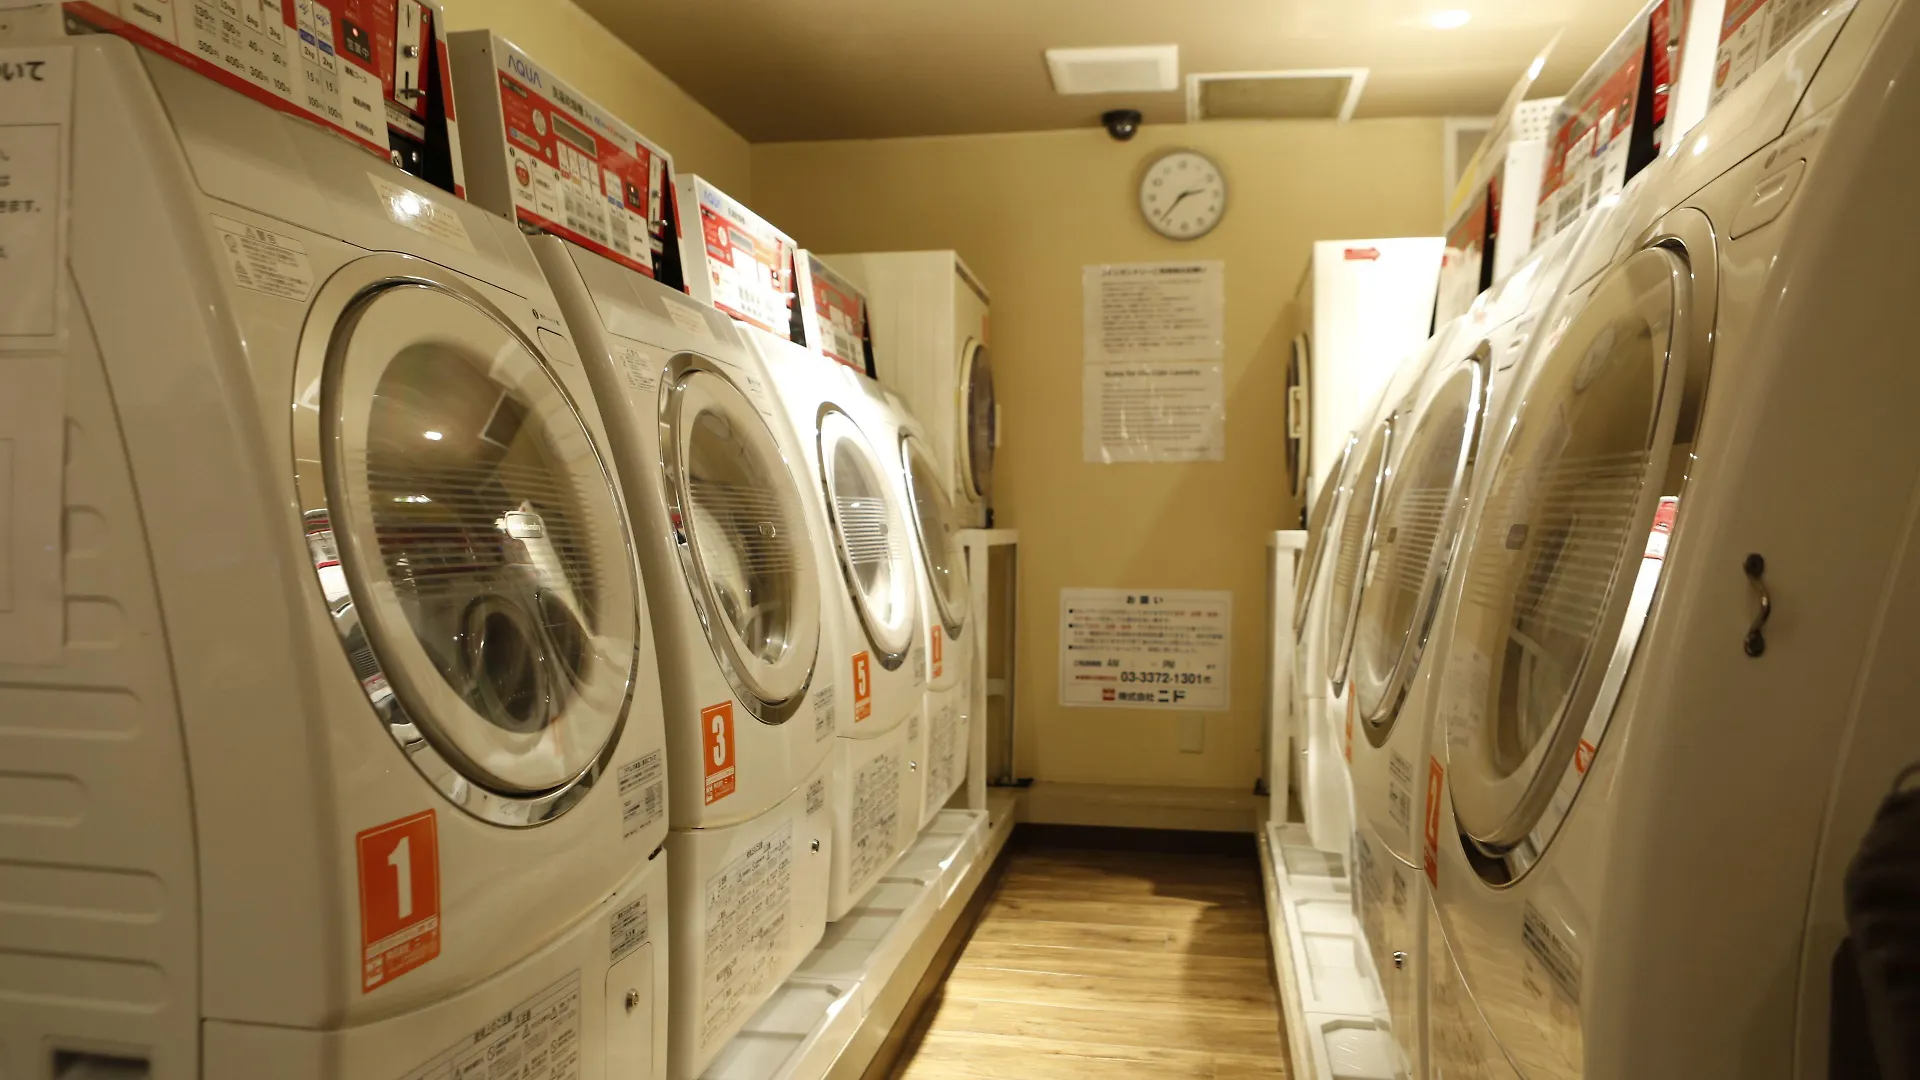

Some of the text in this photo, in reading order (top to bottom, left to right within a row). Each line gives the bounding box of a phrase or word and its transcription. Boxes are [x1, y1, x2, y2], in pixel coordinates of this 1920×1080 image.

[508, 54, 543, 89] AQUA
[857, 660, 867, 696] 5
[712, 714, 726, 766] 3
[387, 835, 413, 920] 1
